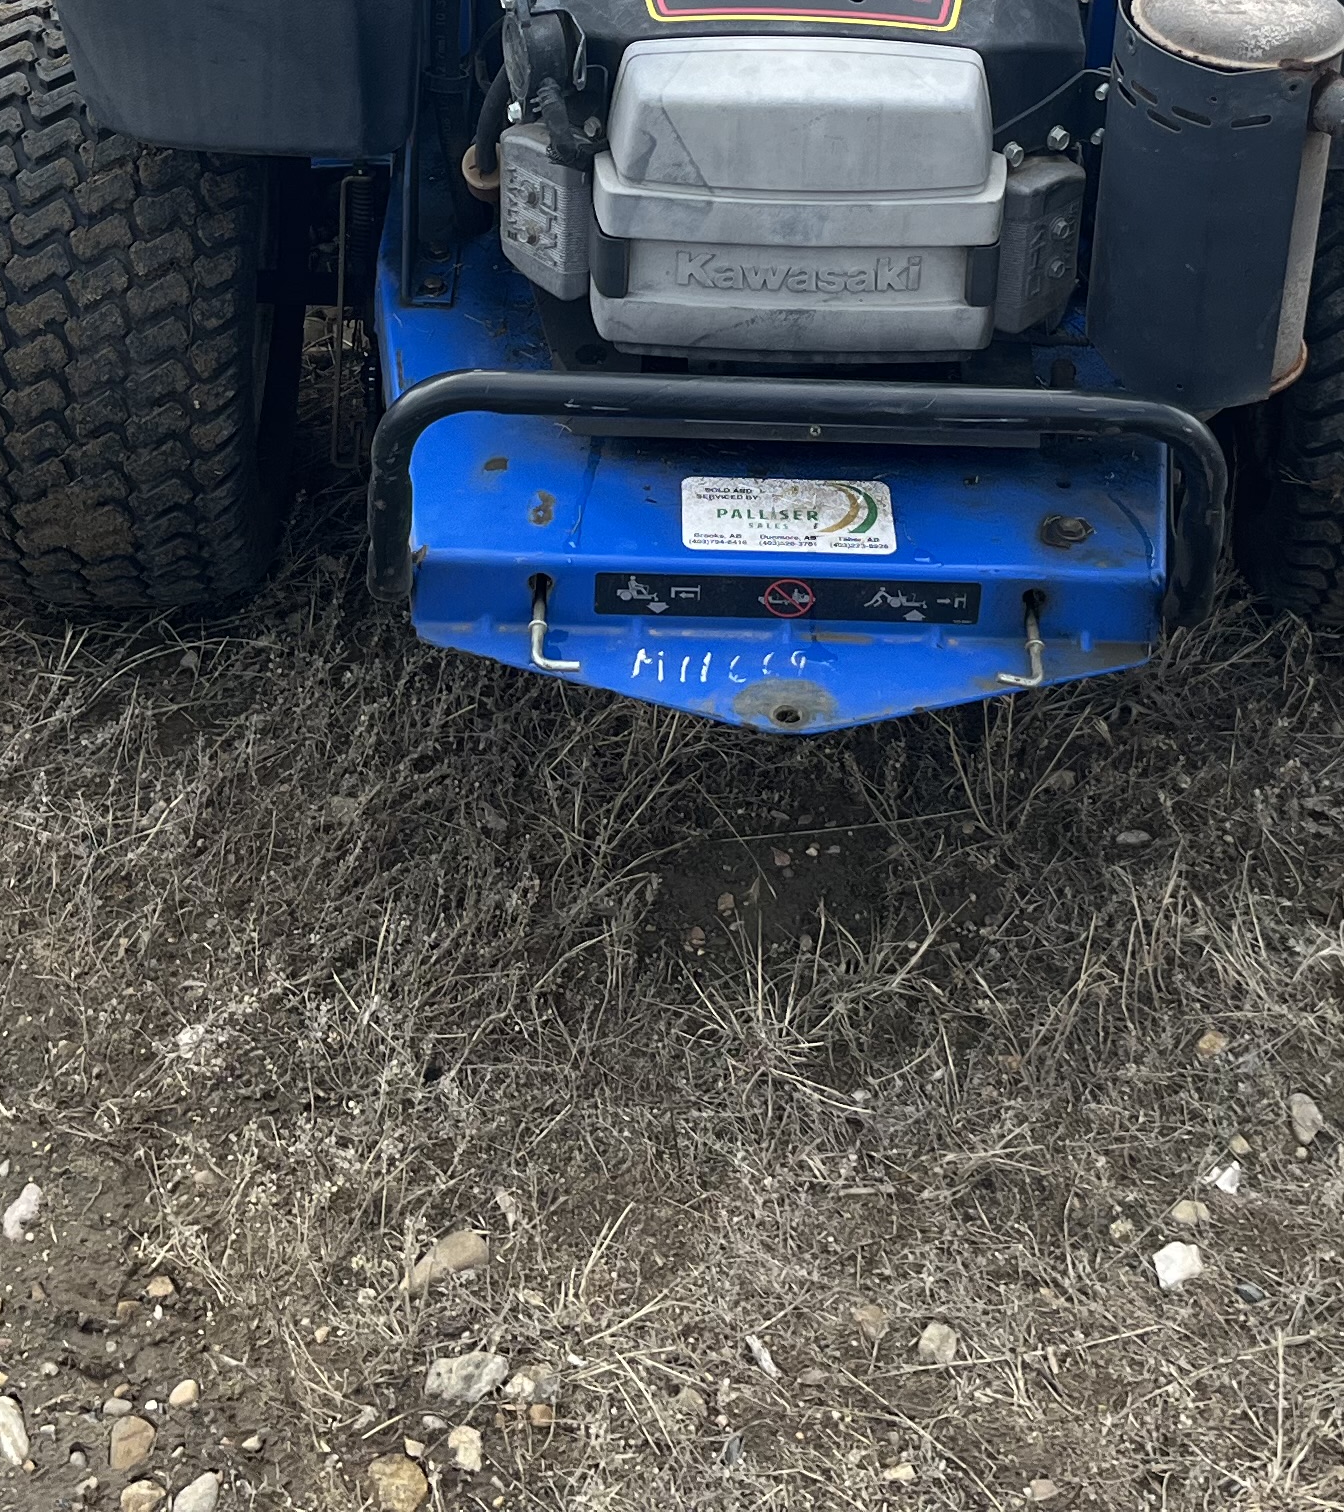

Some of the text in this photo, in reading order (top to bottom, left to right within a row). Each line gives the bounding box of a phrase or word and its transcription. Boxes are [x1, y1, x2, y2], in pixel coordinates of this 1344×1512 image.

[675, 249, 923, 295] Kawasaki
[716, 507, 819, 521] PALLISER
[748, 522, 789, 530] SALES
